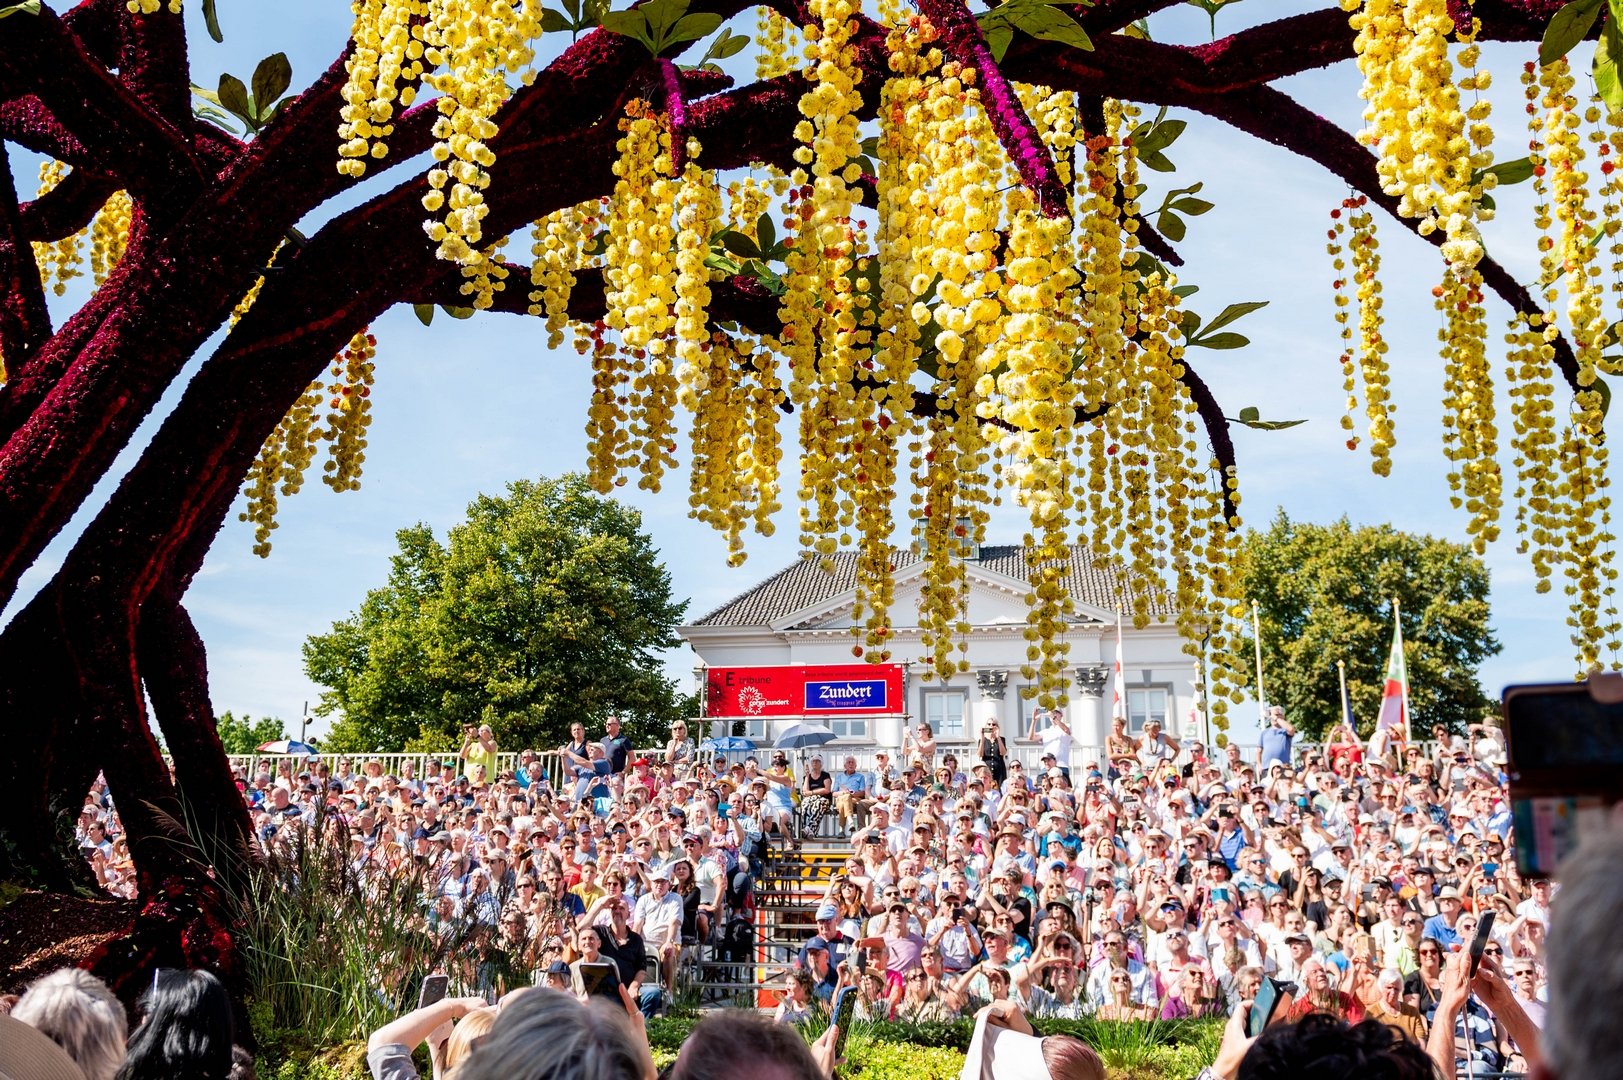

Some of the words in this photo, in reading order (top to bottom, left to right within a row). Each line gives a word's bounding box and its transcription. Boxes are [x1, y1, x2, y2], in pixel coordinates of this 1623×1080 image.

[725, 672, 735, 687] E
[738, 676, 772, 684] tribune
[819, 682, 872, 699] Zundert
